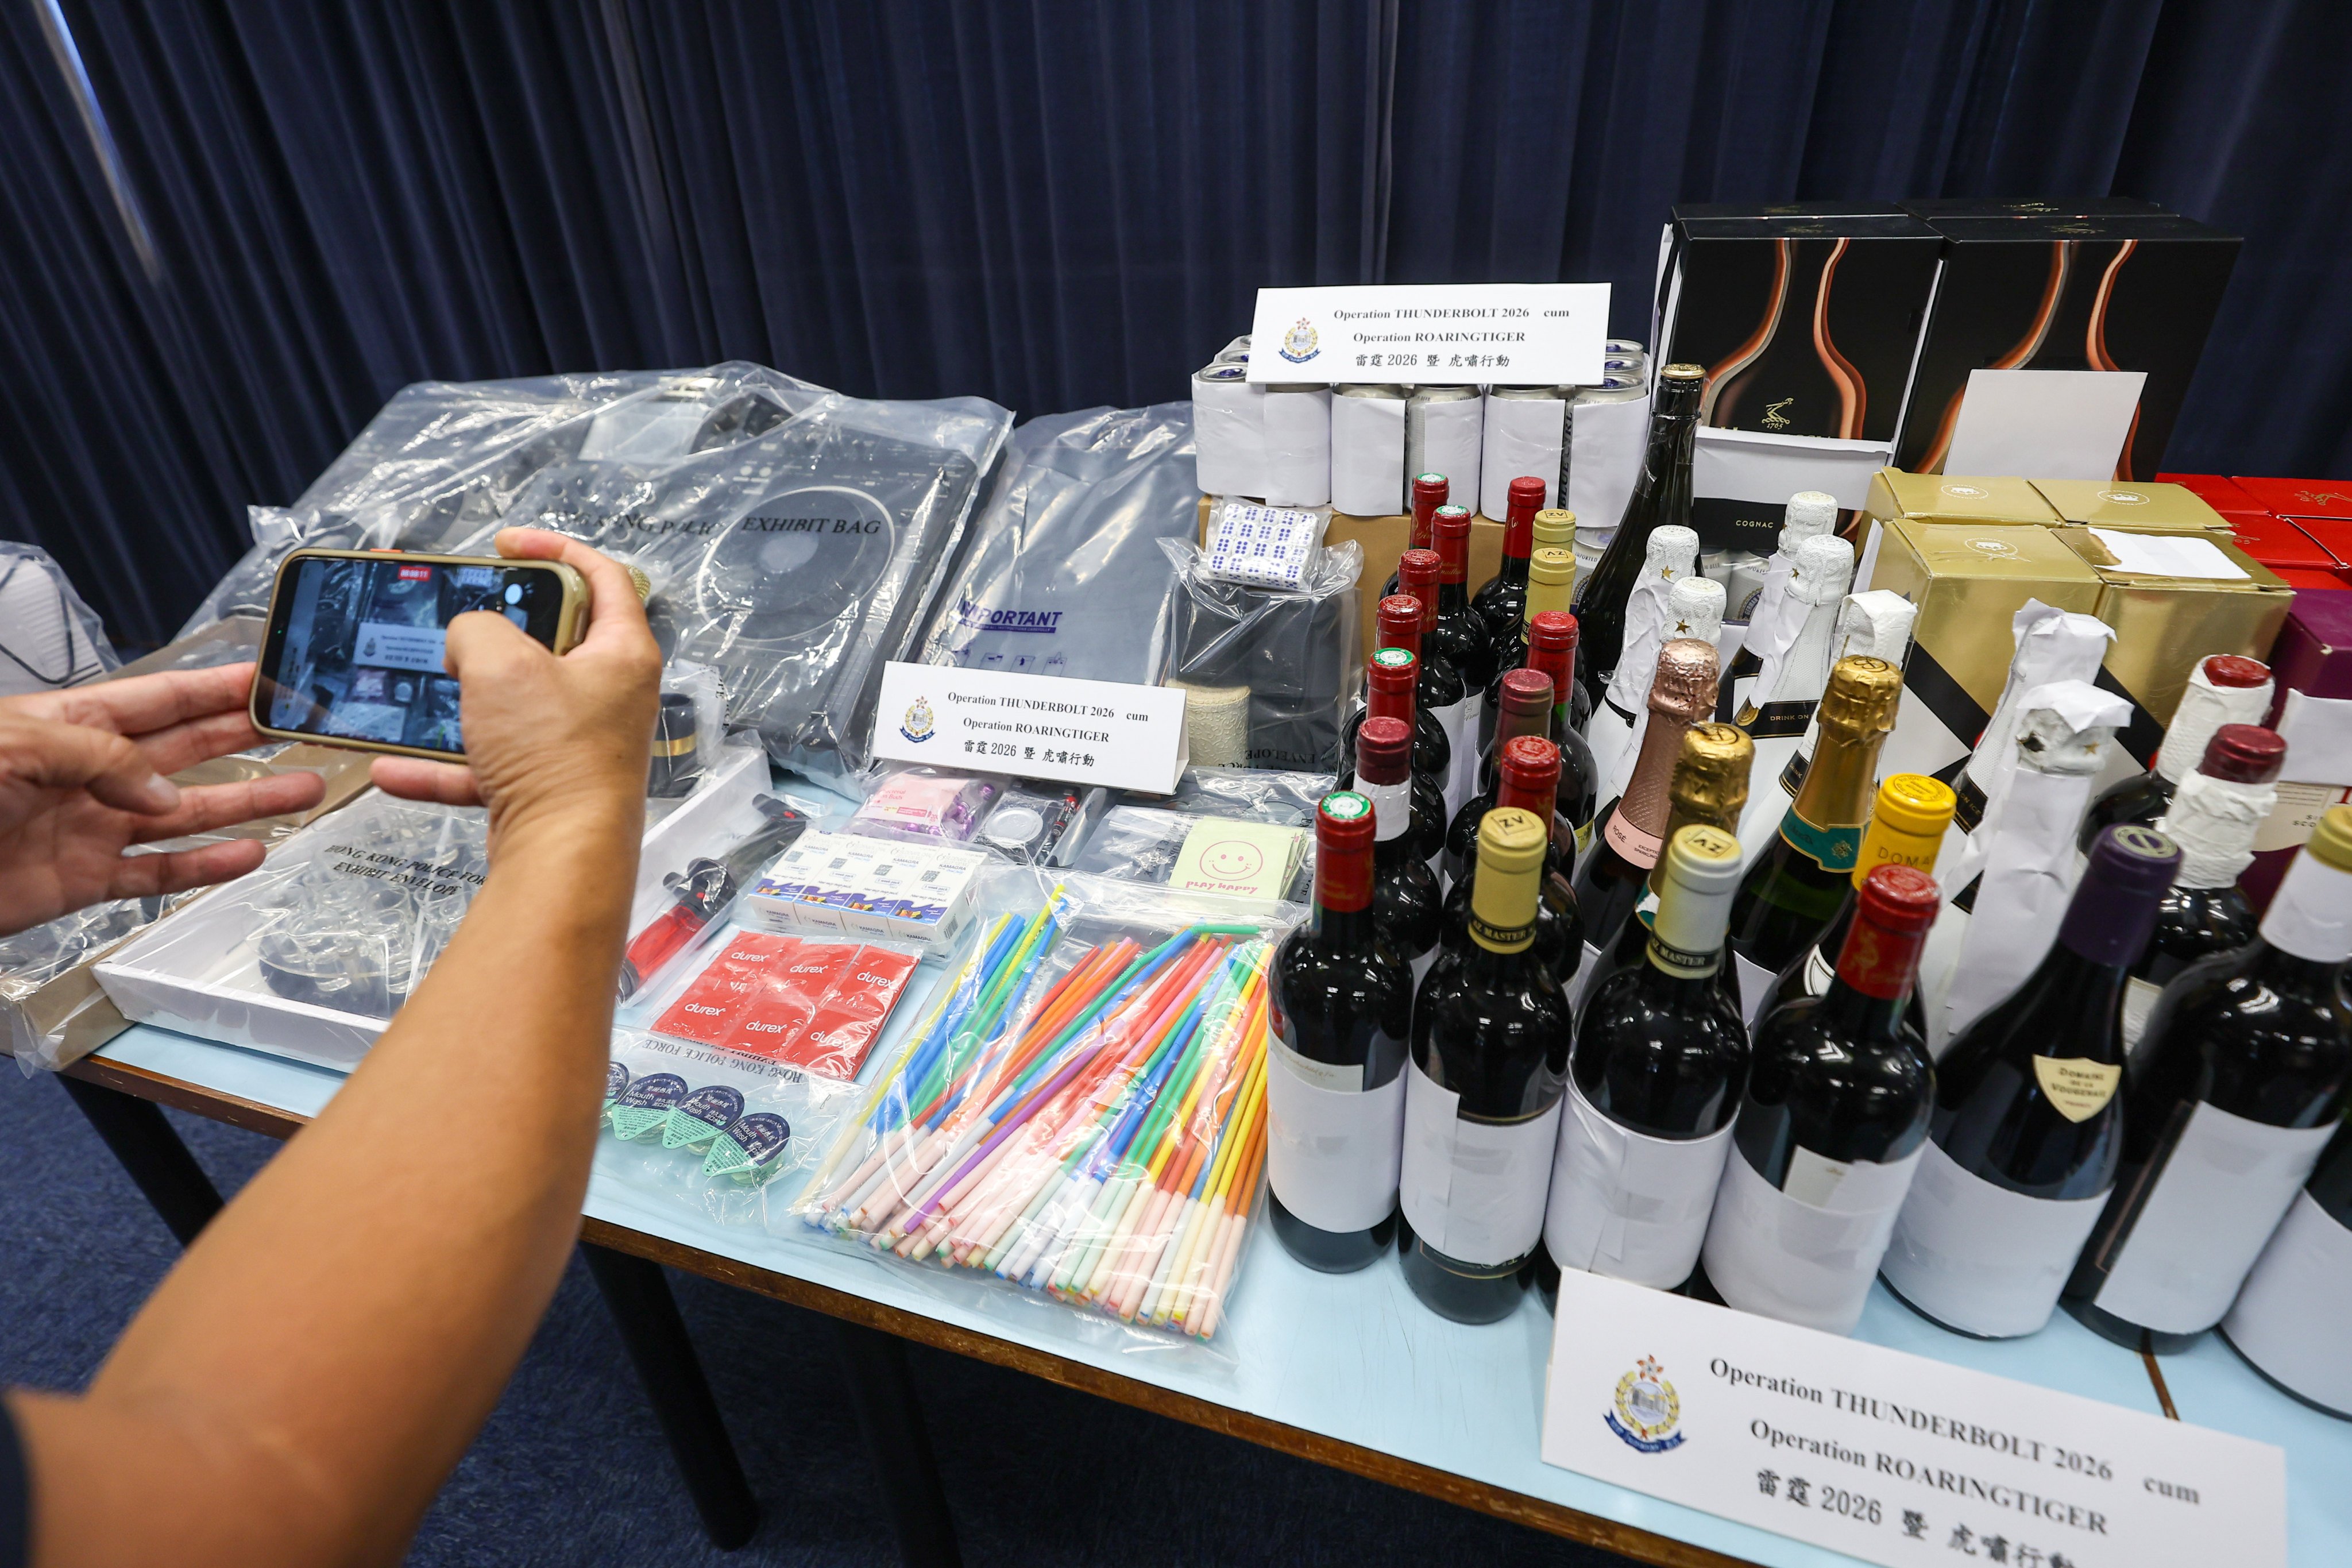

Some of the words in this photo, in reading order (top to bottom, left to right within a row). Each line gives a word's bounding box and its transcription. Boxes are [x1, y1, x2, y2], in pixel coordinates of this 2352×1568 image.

[1334, 309, 1391, 321] Operation
[1395, 308, 1499, 318] THUNDERBOLT
[1501, 308, 1530, 318] 2026
[1543, 309, 1570, 317] cum
[1353, 333, 1411, 343] Operation
[1415, 331, 1525, 342] ROARINGTIGER
[1355, 354, 1383, 367] 雷霆
[1387, 354, 1418, 366] 2026
[1427, 354, 1440, 367] 暨
[1448, 354, 1510, 368] 虎嘯行動
[1559, 462, 1569, 508] BLUE
[742, 516, 827, 535] EXHIBIT
[831, 518, 882, 536] BAG
[1735, 520, 1774, 528] COGNAC
[1575, 553, 1598, 562] IMPORTED
[1744, 597, 1759, 616] GERMAN
[948, 692, 997, 706] Operation
[999, 697, 1088, 715] THUNDERBOLT
[1090, 706, 1115, 718] 2026
[1126, 712, 1149, 721] cum
[963, 717, 1012, 732] Operation
[1015, 723, 1109, 743] ROARINGTIGER
[964, 740, 988, 754] 雷霆
[991, 743, 1017, 756] 2026
[1024, 747, 1036, 760] 暨
[1042, 748, 1095, 767] 虎嘯行動
[1245, 748, 1315, 764] ENVELOPE
[1789, 763, 1802, 779] DRINK
[1959, 793, 1970, 804] ON
[1971, 804, 1982, 816] ICE
[1613, 825, 1627, 843] ROSÉ
[1638, 844, 1660, 855] EXCEPTIO
[1878, 846, 1930, 867] DOMA
[325, 844, 365, 860] HONG
[368, 852, 407, 871] KONG
[409, 860, 459, 882] POLICE
[458, 870, 488, 886] FOR
[938, 863, 967, 871] KAMAGRA
[333, 861, 390, 880] EXHIBIT
[390, 871, 462, 897] ENVELOPE
[1185, 881, 1216, 891] PLAY
[766, 909, 790, 917] KAMAGRA
[812, 918, 836, 927] KAMAGRA
[859, 925, 885, 934] KAMAGRA
[906, 933, 933, 943] KAMAGRA
[1485, 927, 1526, 941] MASTER
[731, 949, 770, 964] durex
[1660, 948, 1706, 966] MASTER
[789, 962, 828, 976] durex
[856, 971, 895, 989] durex
[684, 1001, 726, 1017] durex
[746, 1019, 787, 1035] durex
[642, 1039, 682, 1056] FORCE
[809, 1029, 851, 1050] durex
[685, 1048, 728, 1066] POLICE
[730, 1059, 765, 1075] KONG
[767, 1067, 803, 1083] HONG
[625, 1096, 647, 1106] Wash
[629, 1091, 655, 1100] Mouth
[683, 1103, 702, 1115] Wash
[688, 1097, 710, 1111] Mouth
[732, 1126, 748, 1144] Wash
[740, 1122, 758, 1140] Mouth
[1710, 1357, 1824, 1404] Operation
[1831, 1387, 2046, 1462] THUNDERBOLT
[2054, 1447, 2113, 1481] 2026
[2144, 1476, 2200, 1505] cum
[1750, 1418, 1867, 1468] Operation
[1875, 1451, 2109, 1535] ROARINGTIGER
[1757, 1467, 1812, 1508] 雷霆
[1821, 1485, 1882, 1525] 2026
[1902, 1507, 1929, 1541] 暨
